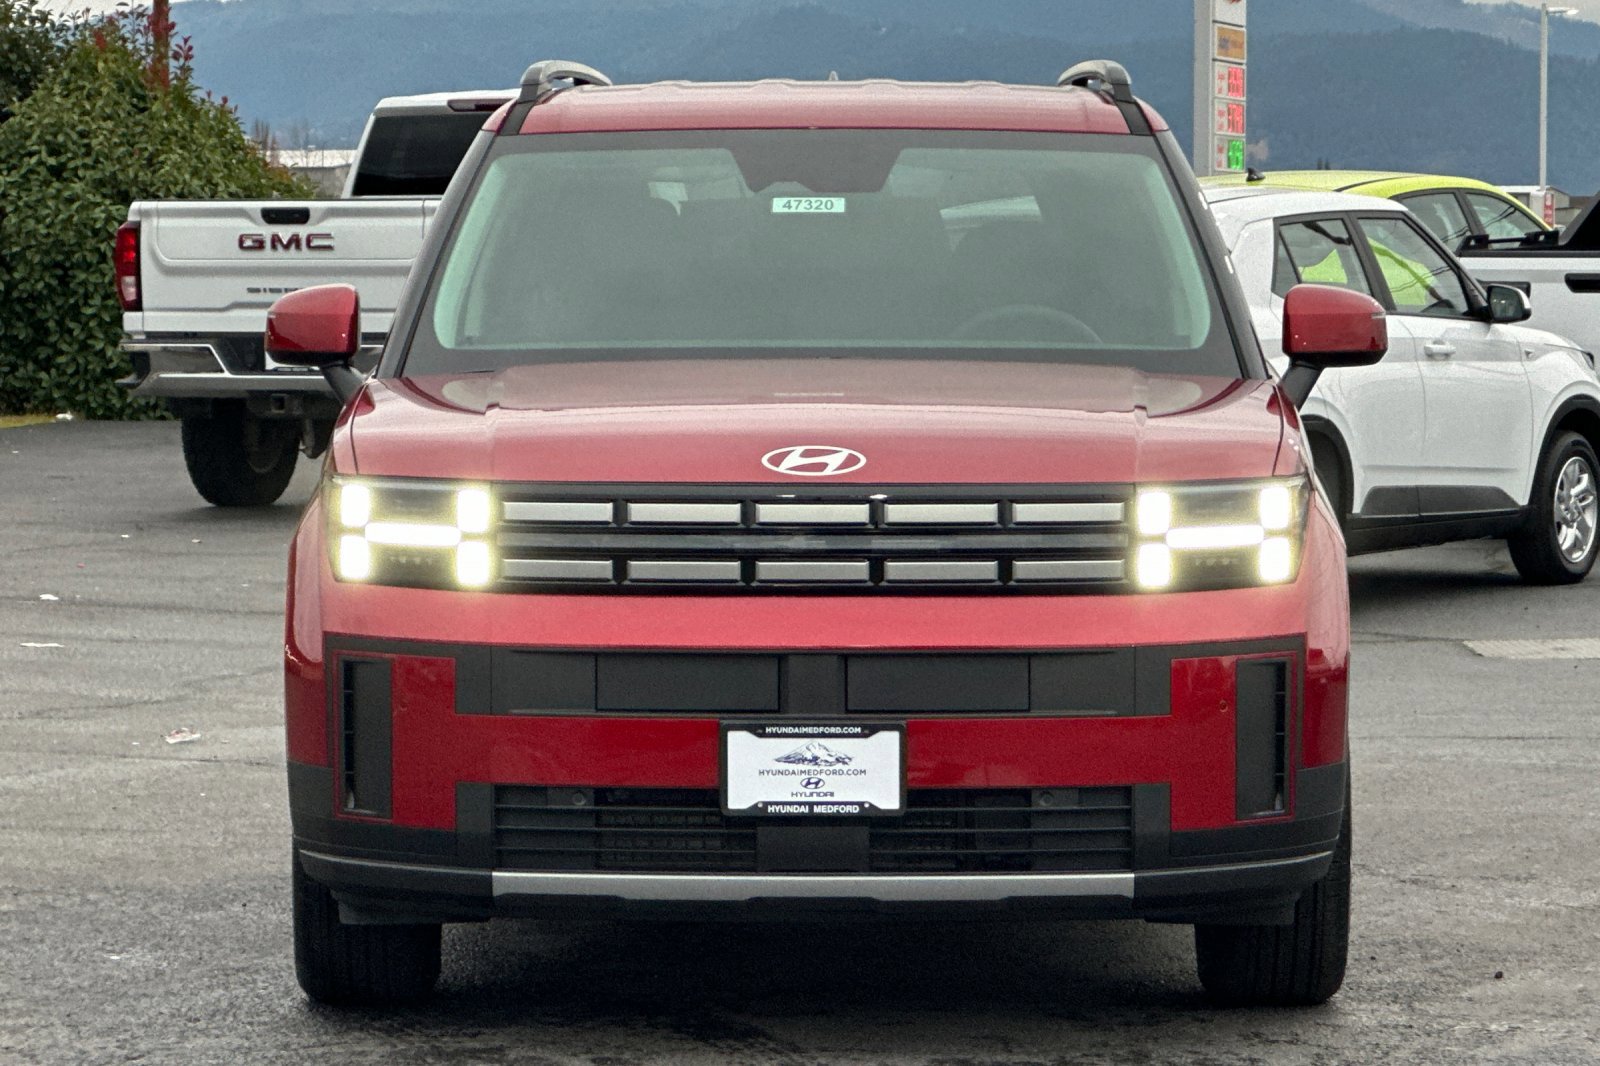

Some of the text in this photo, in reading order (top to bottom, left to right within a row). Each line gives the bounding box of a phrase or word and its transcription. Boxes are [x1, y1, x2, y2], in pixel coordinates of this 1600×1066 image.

[782, 199, 834, 211] 47320
[238, 233, 335, 251] GMC
[767, 804, 860, 814] HYUNDAI MEDFORD
